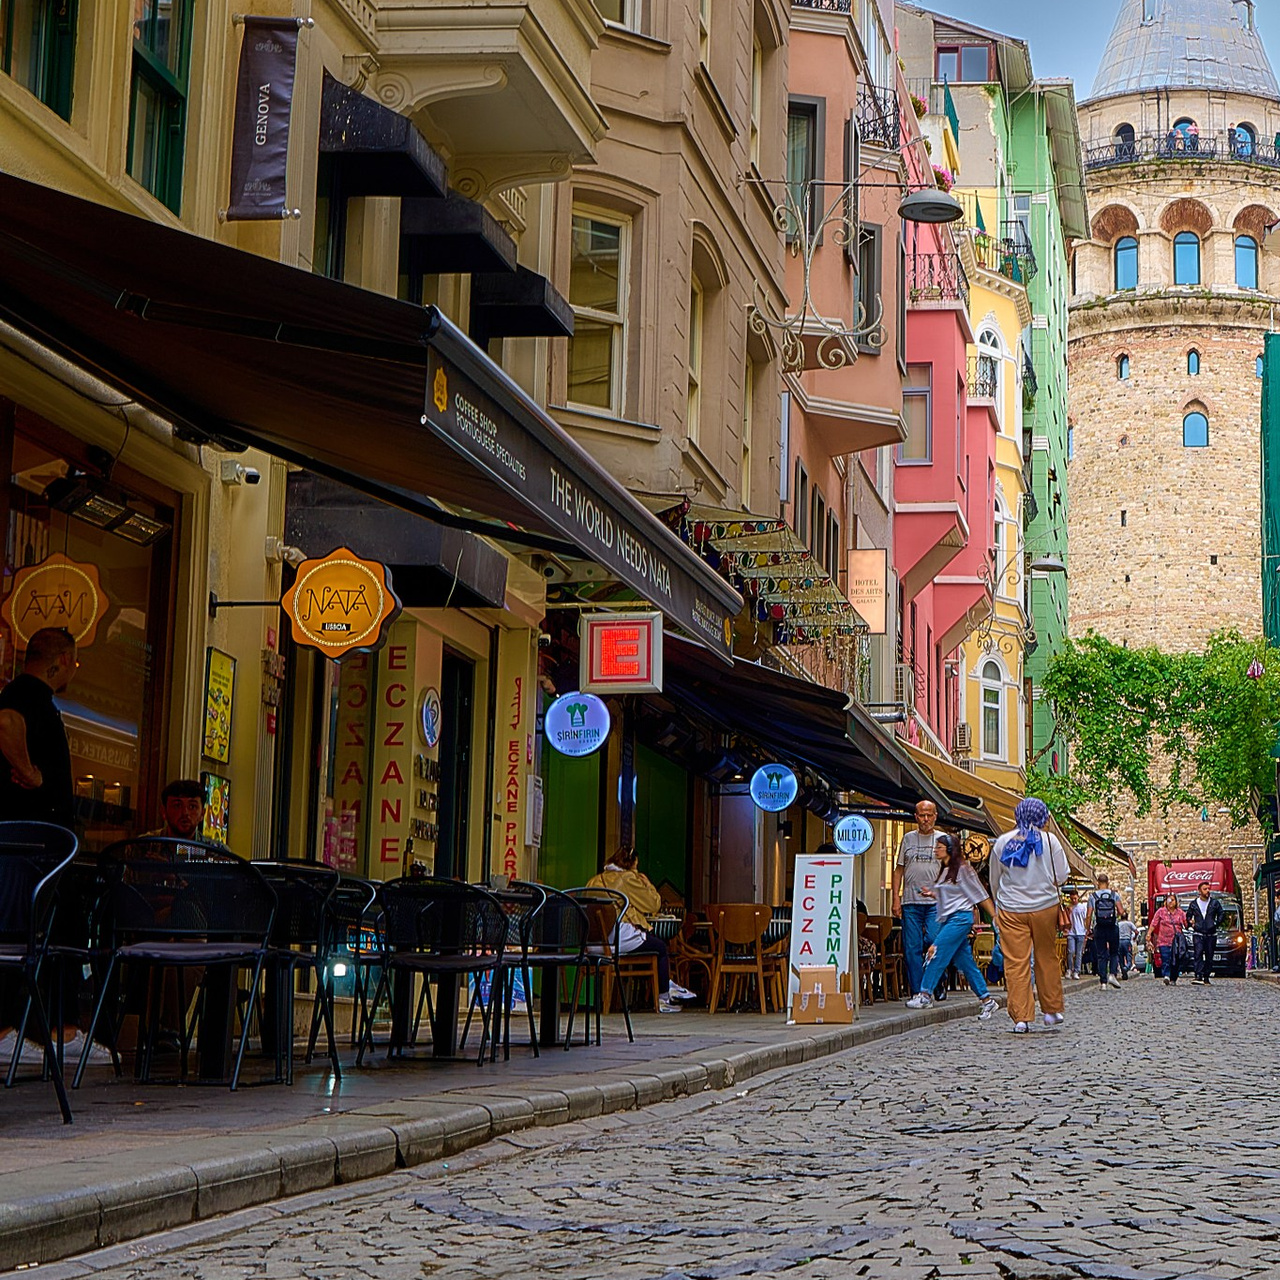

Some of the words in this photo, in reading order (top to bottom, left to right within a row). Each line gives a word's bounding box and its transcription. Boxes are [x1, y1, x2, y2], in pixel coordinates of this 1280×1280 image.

[255, 82, 271, 147] GENOVA
[455, 392, 479, 424] COFFEE
[479, 412, 498, 438] SHOP
[456, 410, 496, 456] PORTUGUESE
[550, 467, 573, 517] THE
[574, 487, 614, 550] WORLD
[616, 523, 649, 579] NEEDS
[649, 552, 673, 599] NATA
[302, 584, 373, 621] NATA
[601, 628, 640, 677] E
[379, 645, 408, 863] ECZANE
[505, 740, 520, 813] ECZANE
[503, 822, 518, 883] PHARM
[799, 874, 816, 958] ECZA
[826, 873, 843, 968] PHARMA
